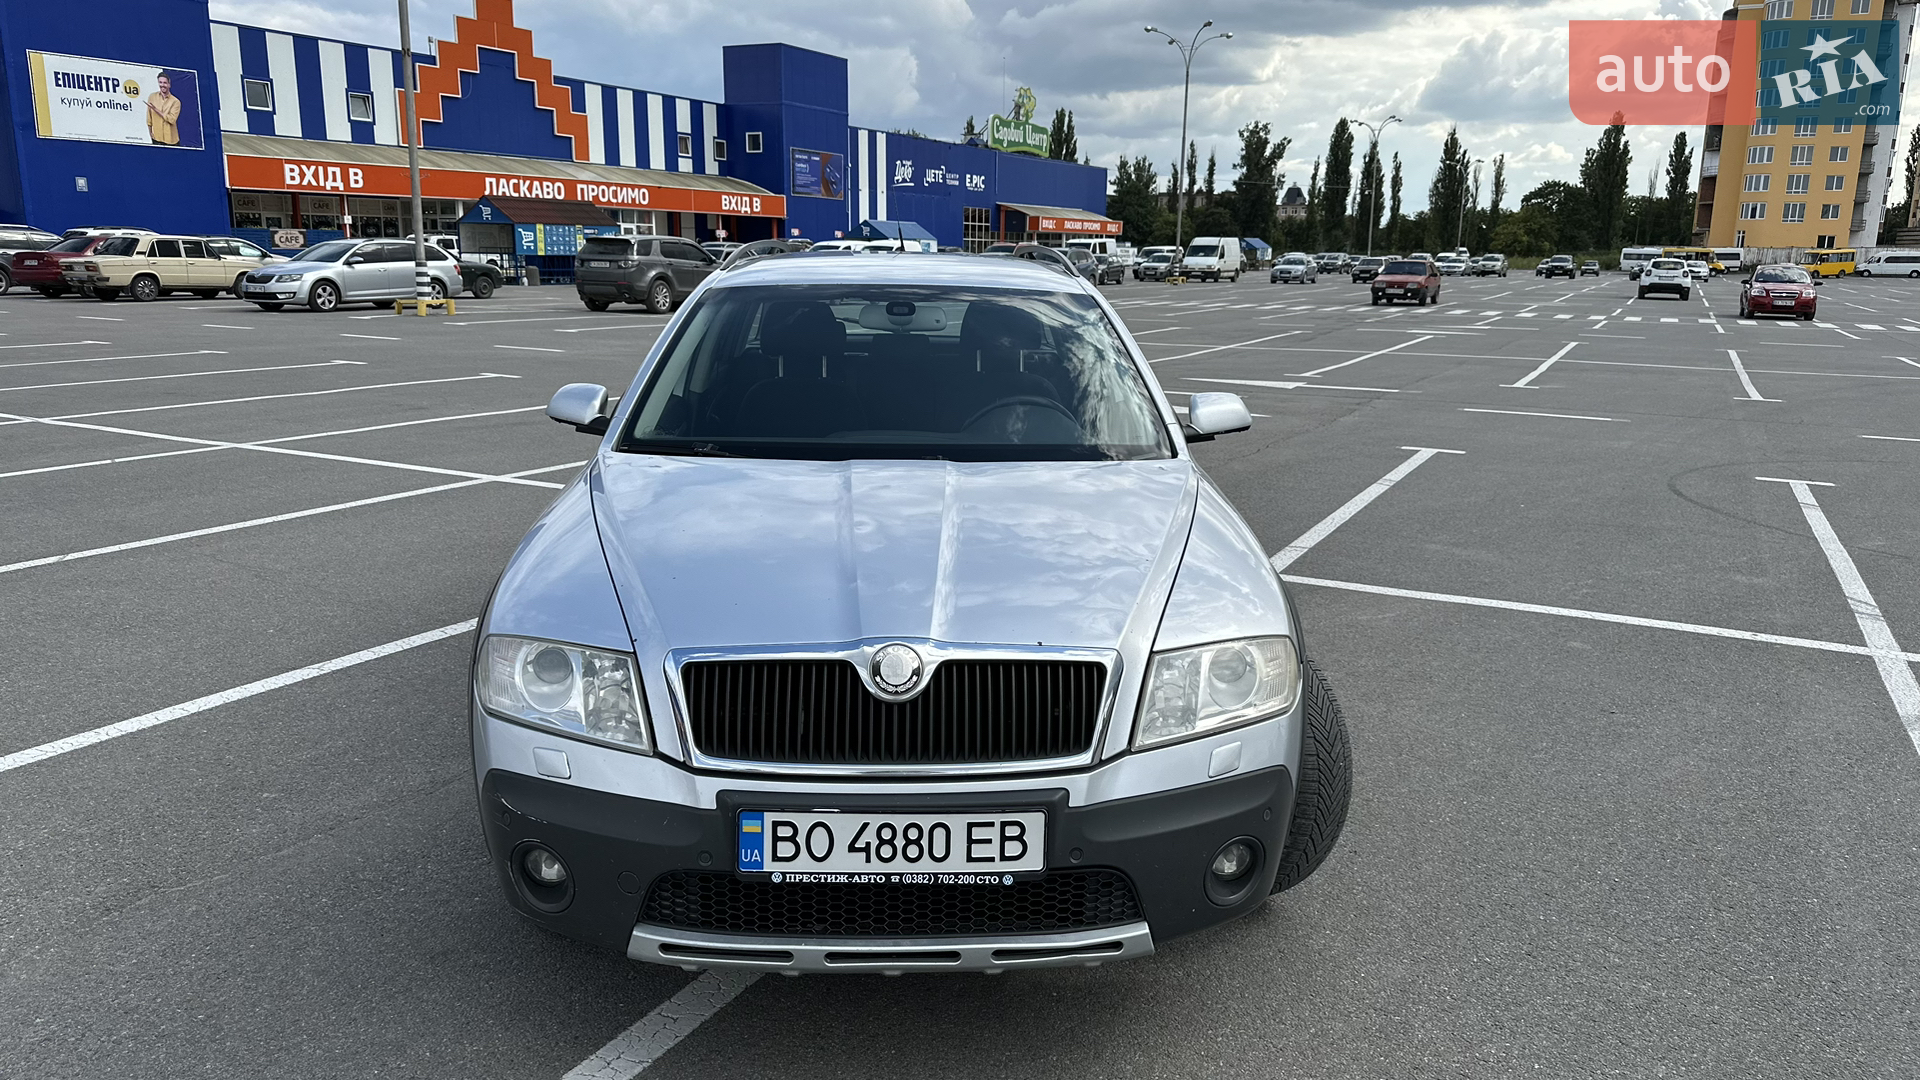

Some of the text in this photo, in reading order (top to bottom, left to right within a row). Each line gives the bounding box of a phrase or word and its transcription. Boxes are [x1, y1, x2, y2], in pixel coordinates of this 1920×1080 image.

[53, 70, 140, 97] ЕПІЦЕНТР ua
[60, 96, 133, 112] купуй online!
[1025, 124, 1048, 152] Центр
[284, 163, 364, 191] ВХІД В
[925, 168, 944, 184] ЦЕТЕ
[965, 174, 985, 189] E.PIC
[484, 176, 649, 205] ЛАСКАВО ПРОСИМО
[313, 201, 330, 210] CAFE
[721, 194, 761, 214] ВХІД В
[278, 235, 300, 244] CAFE
[847, 821, 952, 863] 4880
[741, 849, 762, 862] UA
[785, 873, 886, 883] ПРЕСТИЖ-АВТО
[902, 873, 935, 885] (0382)
[937, 874, 975, 884] 702-200
[976, 875, 1000, 884] СТО
